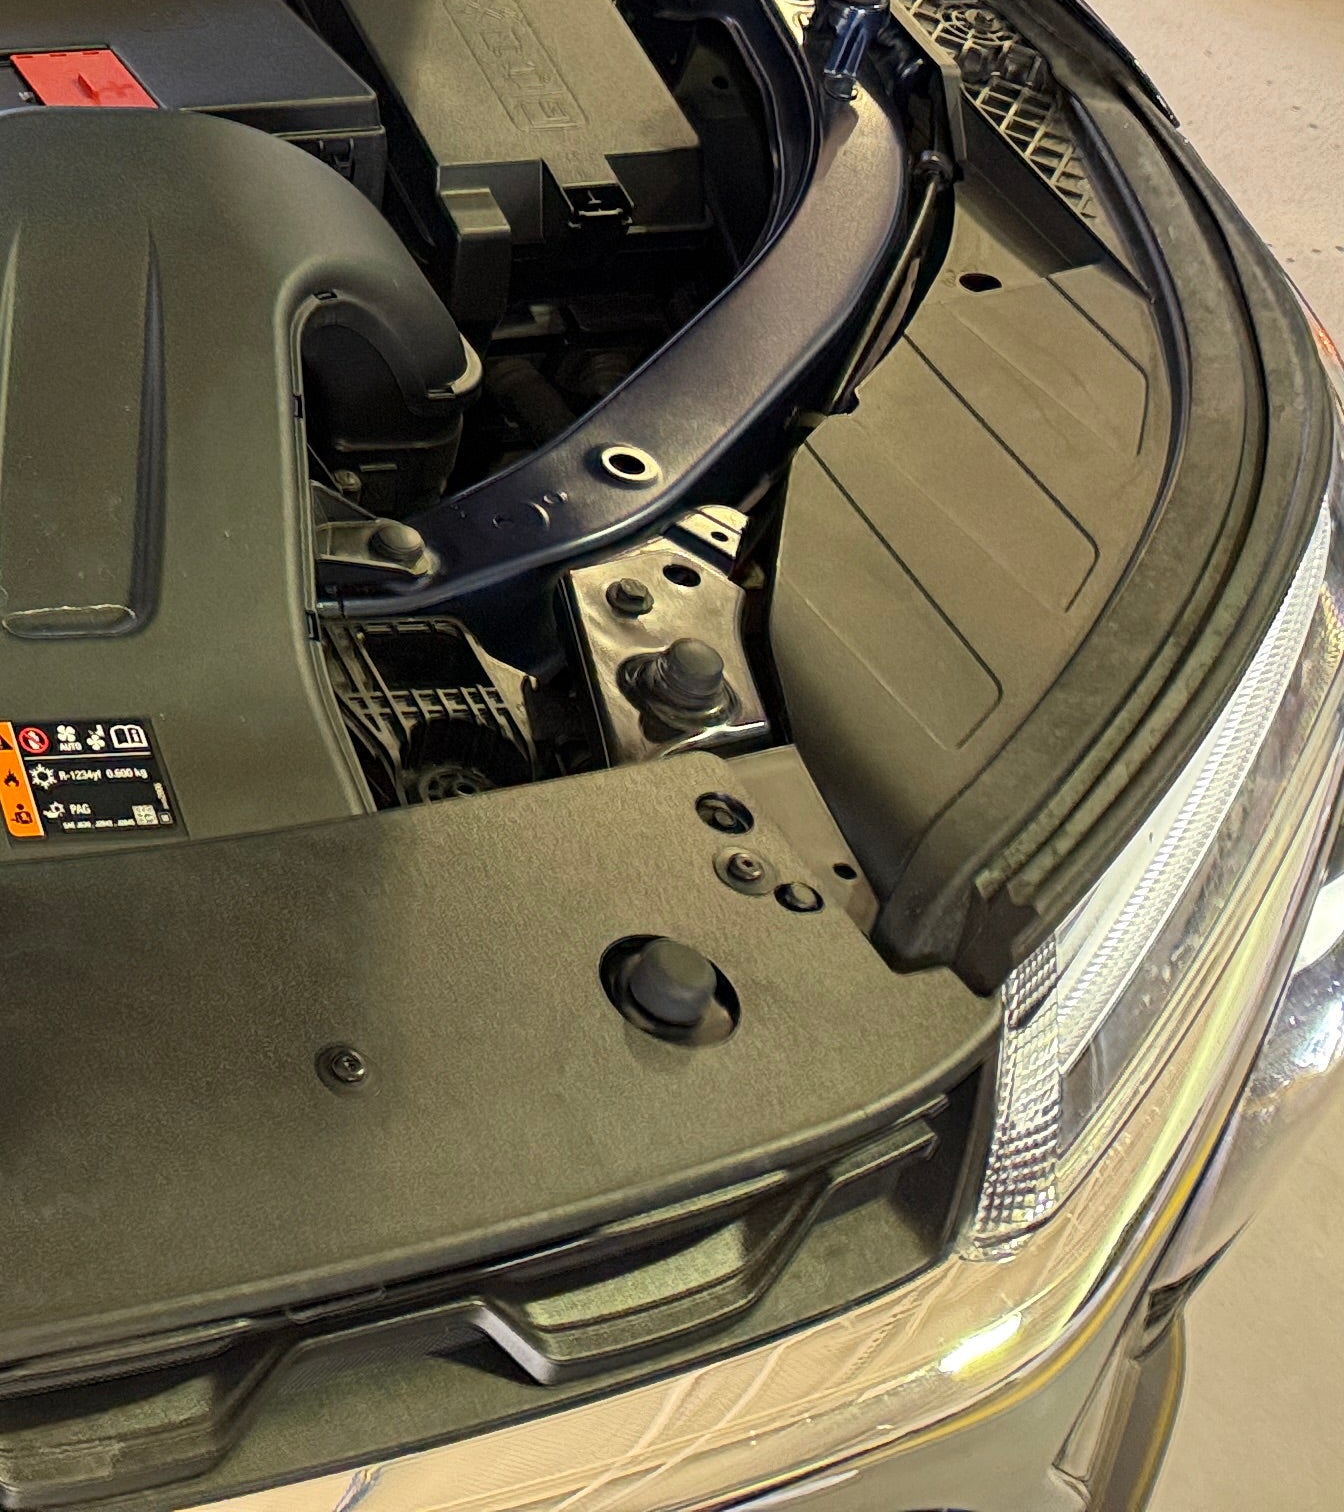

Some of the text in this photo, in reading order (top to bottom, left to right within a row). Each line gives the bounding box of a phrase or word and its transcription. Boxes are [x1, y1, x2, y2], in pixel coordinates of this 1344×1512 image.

[59, 742, 82, 751] AUTO
[59, 769, 101, 781] R-1234yf
[133, 767, 148, 779] kg
[69, 803, 91, 814] PAG
